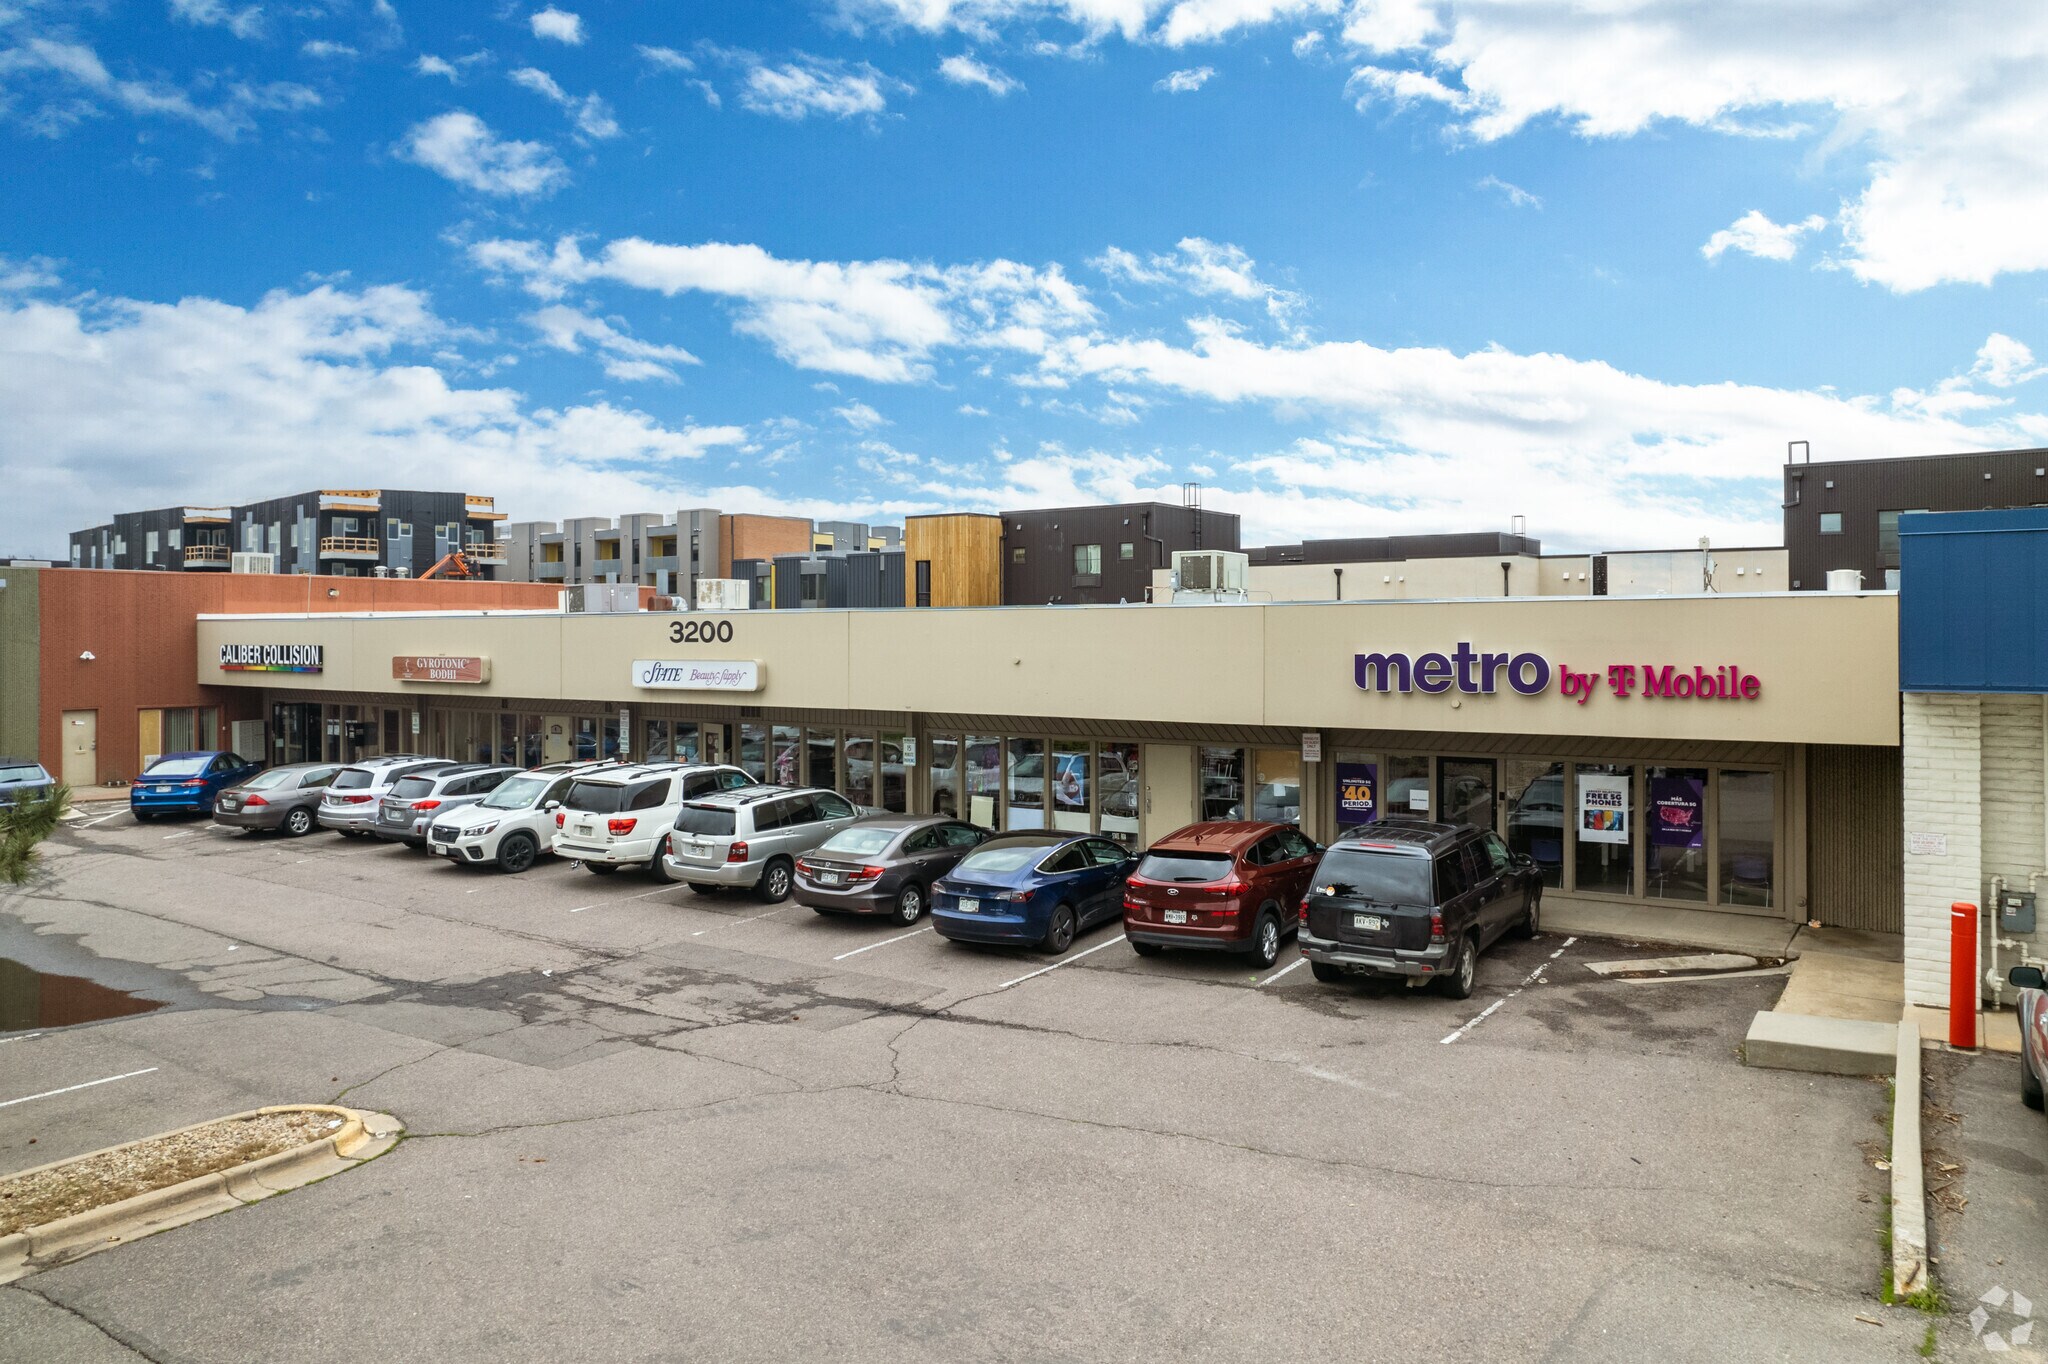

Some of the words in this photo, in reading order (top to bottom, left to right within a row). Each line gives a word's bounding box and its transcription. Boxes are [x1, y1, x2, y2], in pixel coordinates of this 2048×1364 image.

[669, 620, 734, 643] 3200
[220, 644, 261, 664] CALIBER
[416, 657, 467, 669] GYROTONIC
[430, 669, 457, 680] BODHI
[643, 661, 683, 684] STATE
[689, 668, 719, 686] Beauty
[716, 668, 747, 686] Supply
[1354, 642, 1550, 695] metro
[1559, 664, 1599, 704] by
[1642, 664, 1762, 699] Mobile
